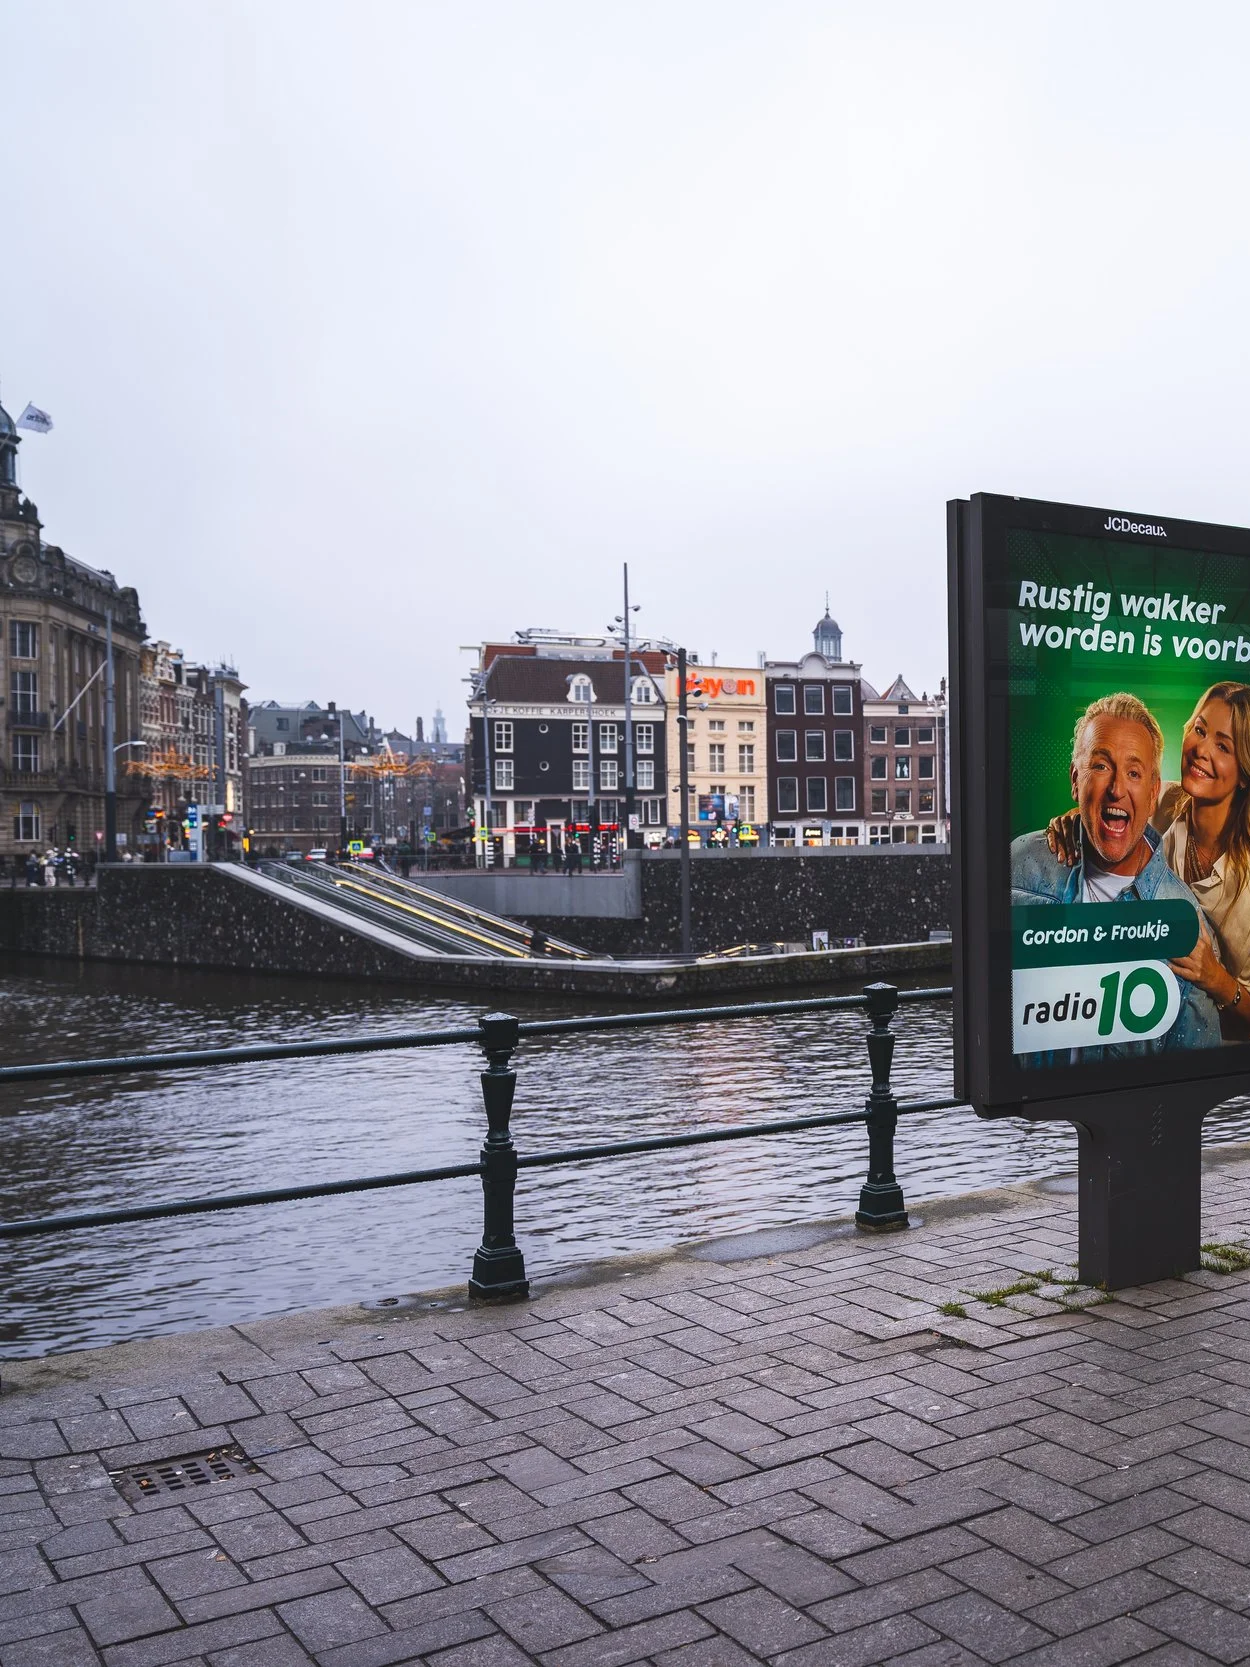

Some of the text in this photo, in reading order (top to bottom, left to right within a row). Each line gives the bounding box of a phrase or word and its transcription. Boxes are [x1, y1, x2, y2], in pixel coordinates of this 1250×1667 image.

[1104, 516, 1167, 537] JCDecaux
[1018, 580, 1226, 625] Rustig wakker
[1019, 623, 1135, 654] worden
[1142, 625, 1162, 656] is
[1022, 919, 1170, 946] Gordon & Froukje
[1022, 967, 1168, 1036] radio 10
